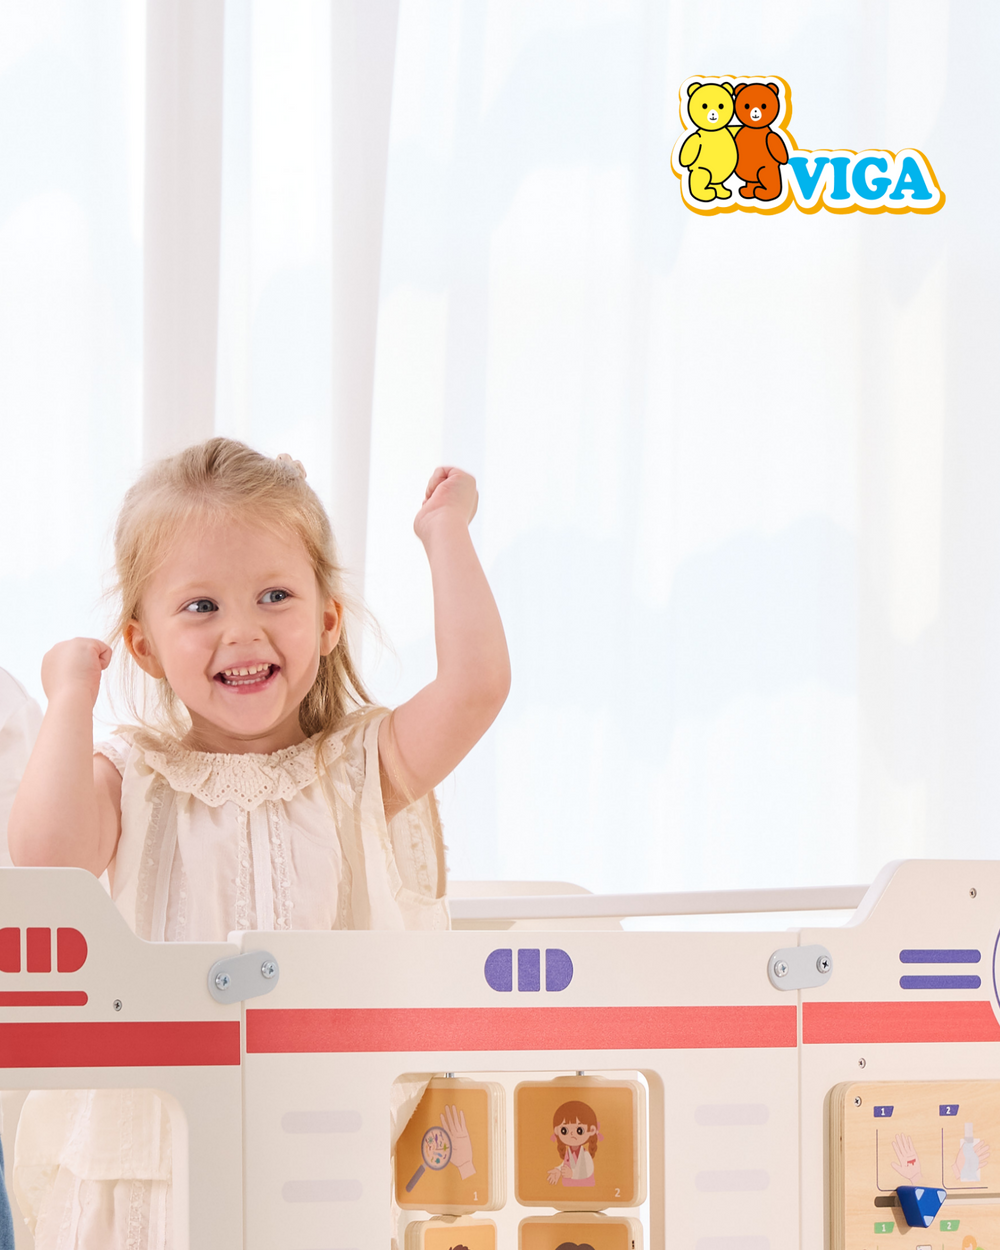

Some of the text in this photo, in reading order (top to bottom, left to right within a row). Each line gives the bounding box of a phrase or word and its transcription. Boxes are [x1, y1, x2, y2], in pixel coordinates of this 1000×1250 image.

[881, 1108, 886, 1116] 1
[946, 1106, 951, 1115] 2
[473, 1191, 478, 1201] 1
[614, 1188, 621, 1198] 2
[881, 1224, 886, 1232] 1
[946, 1222, 952, 1230] 2
